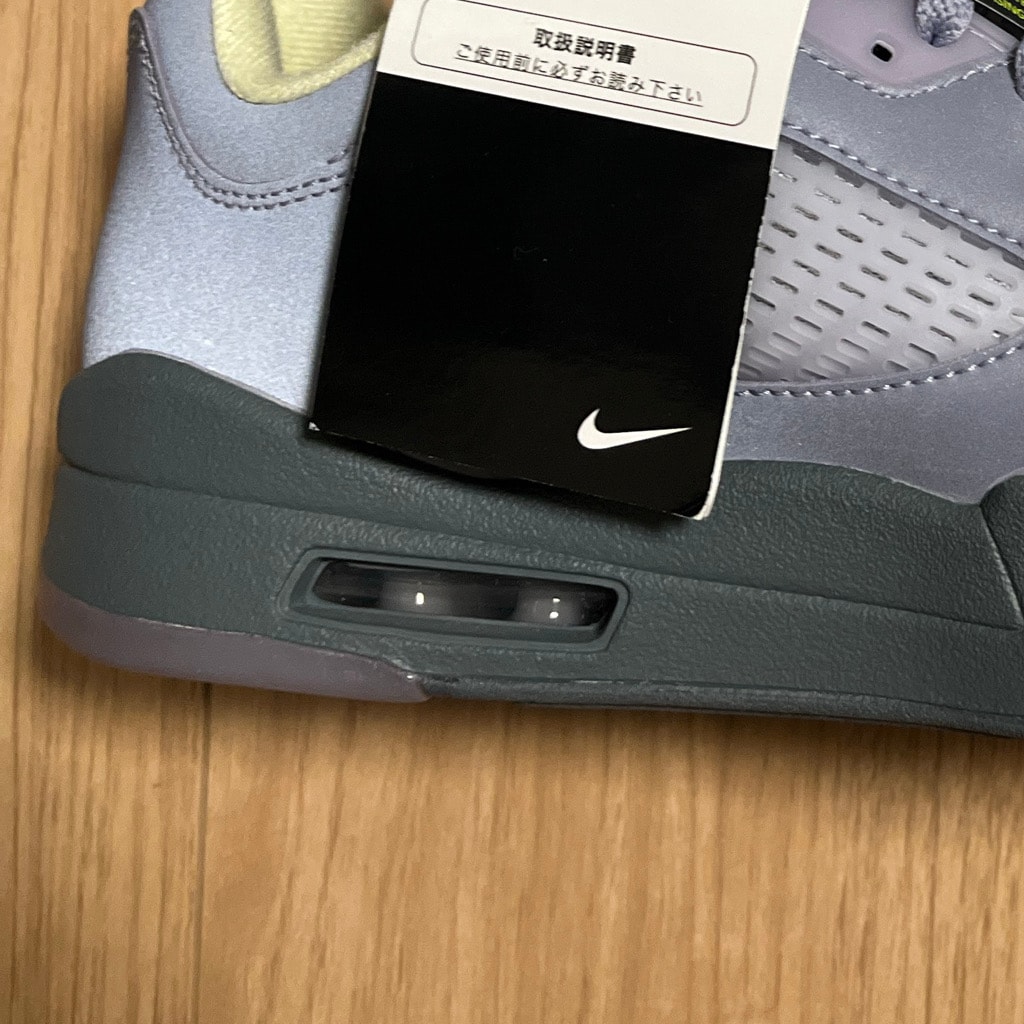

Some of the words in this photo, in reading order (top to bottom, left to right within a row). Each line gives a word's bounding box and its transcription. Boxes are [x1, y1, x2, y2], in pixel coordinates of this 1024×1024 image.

[533, 27, 637, 65] 取扱説明書
